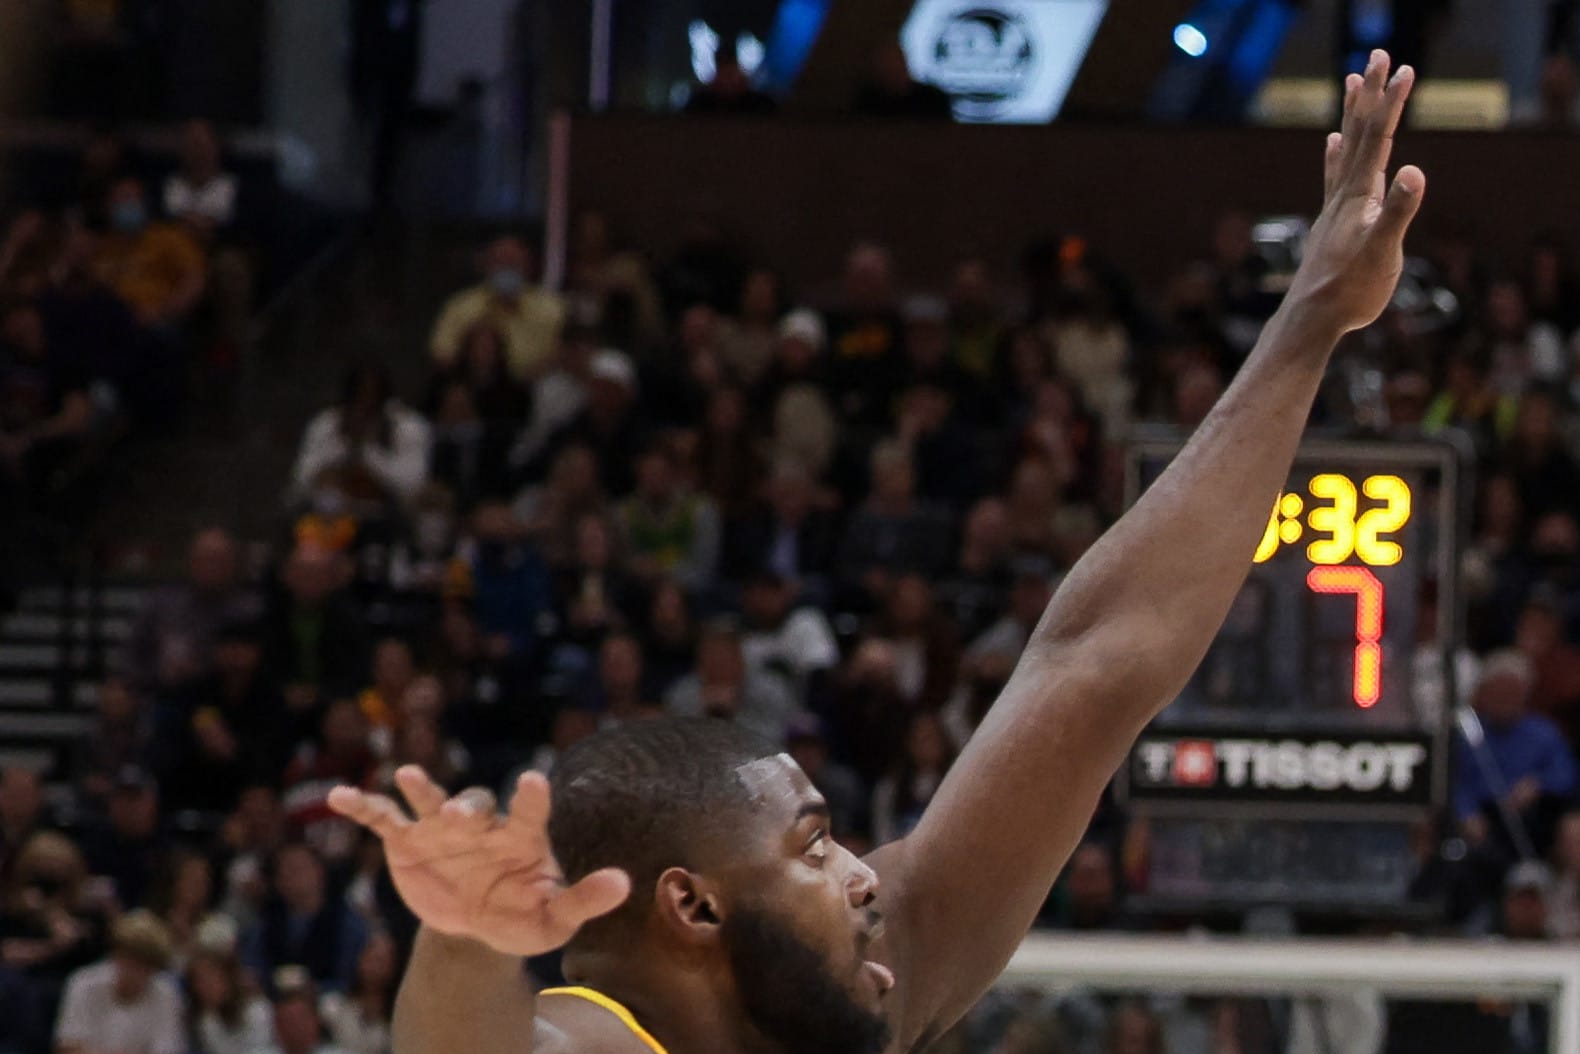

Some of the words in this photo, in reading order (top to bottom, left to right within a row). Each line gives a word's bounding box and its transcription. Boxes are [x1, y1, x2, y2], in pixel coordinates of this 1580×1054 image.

[1253, 474, 1411, 566] :32
[1307, 565, 1384, 708] 7
[1214, 741, 1426, 791] TISSOT
